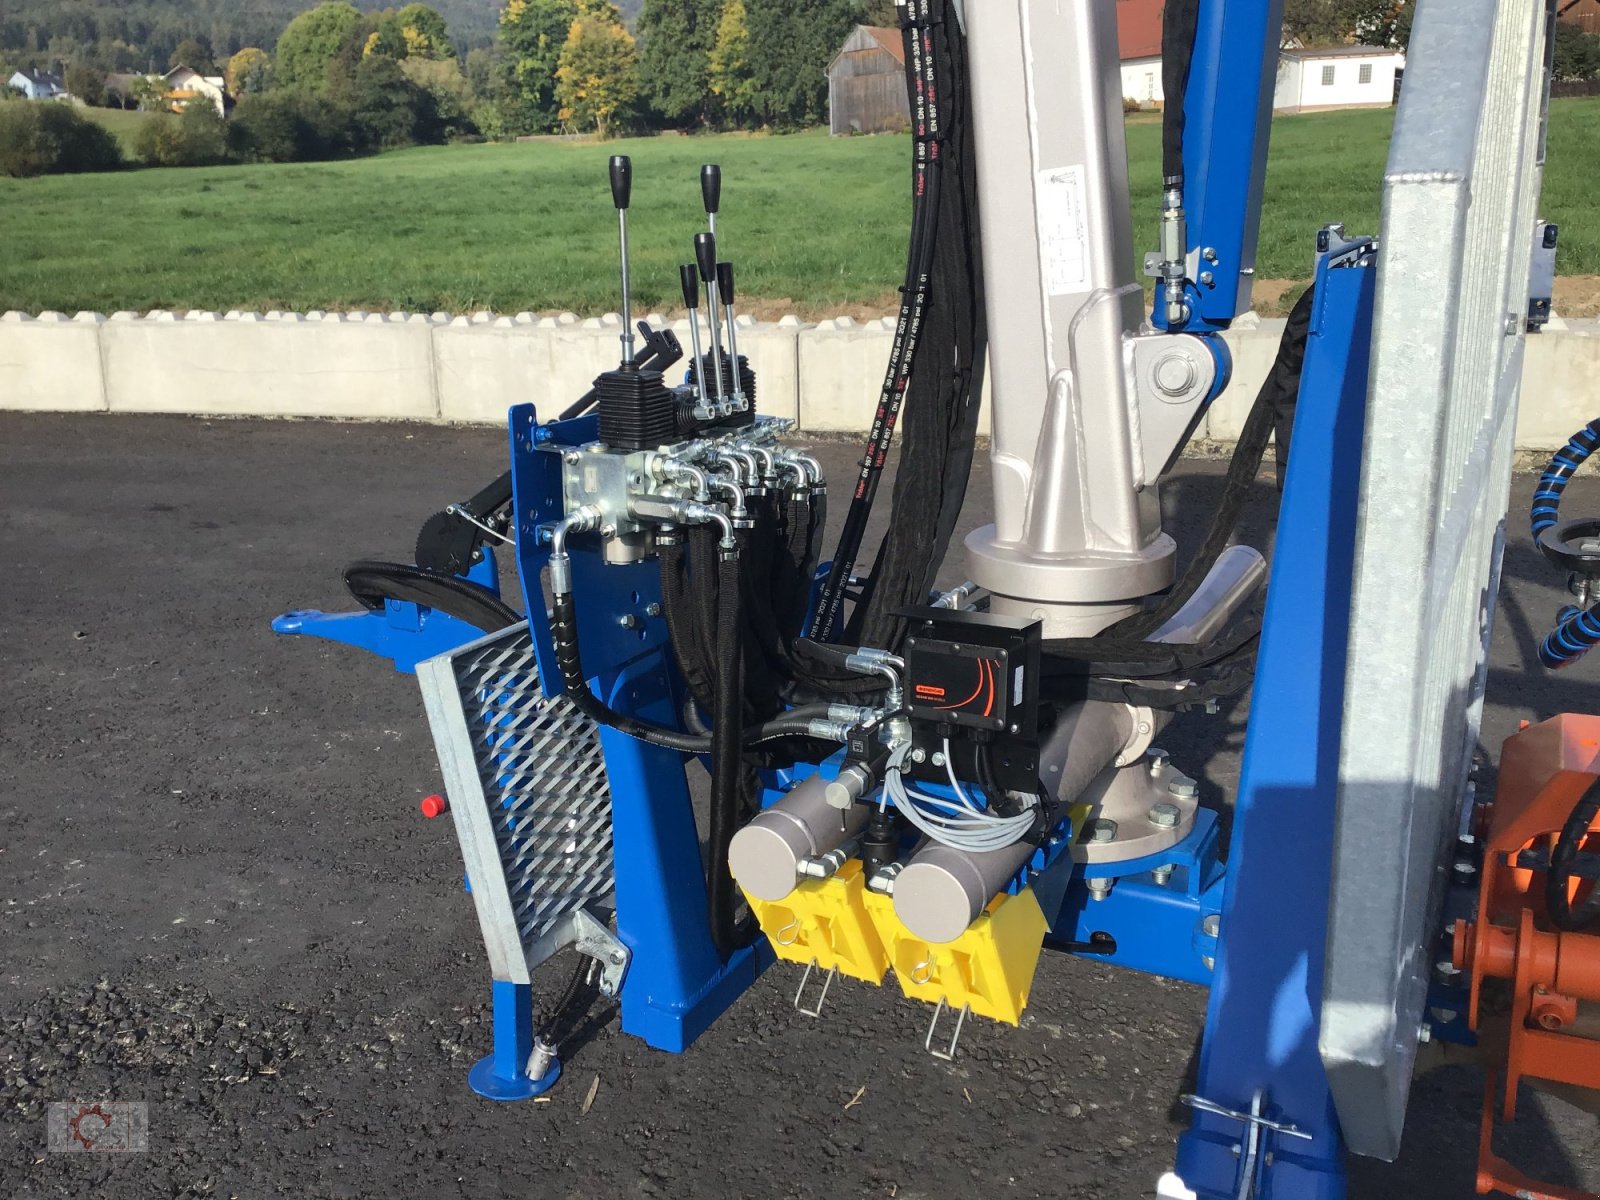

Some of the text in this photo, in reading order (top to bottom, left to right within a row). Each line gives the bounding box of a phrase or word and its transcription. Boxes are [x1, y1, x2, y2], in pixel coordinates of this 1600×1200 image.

[908, 1, 916, 20] 4785
[913, 41, 921, 56] 330
[914, 58, 922, 72] WP
[925, 56, 933, 66] 10
[927, 67, 935, 80] DN
[917, 96, 924, 107] 10
[918, 107, 925, 120] DN
[929, 103, 937, 118] 857
[930, 120, 938, 132] EN
[911, 318, 920, 335] 4785
[908, 339, 916, 350] bar
[892, 347, 901, 364] 4785
[905, 350, 913, 363] 330
[888, 368, 896, 379] bar
[901, 363, 909, 375] WP
[894, 393, 902, 401] 10
[891, 402, 900, 412] DN
[874, 420, 882, 428] 10
[871, 429, 880, 440] DN
[881, 440, 889, 450] EN
[861, 468, 870, 478] EN
